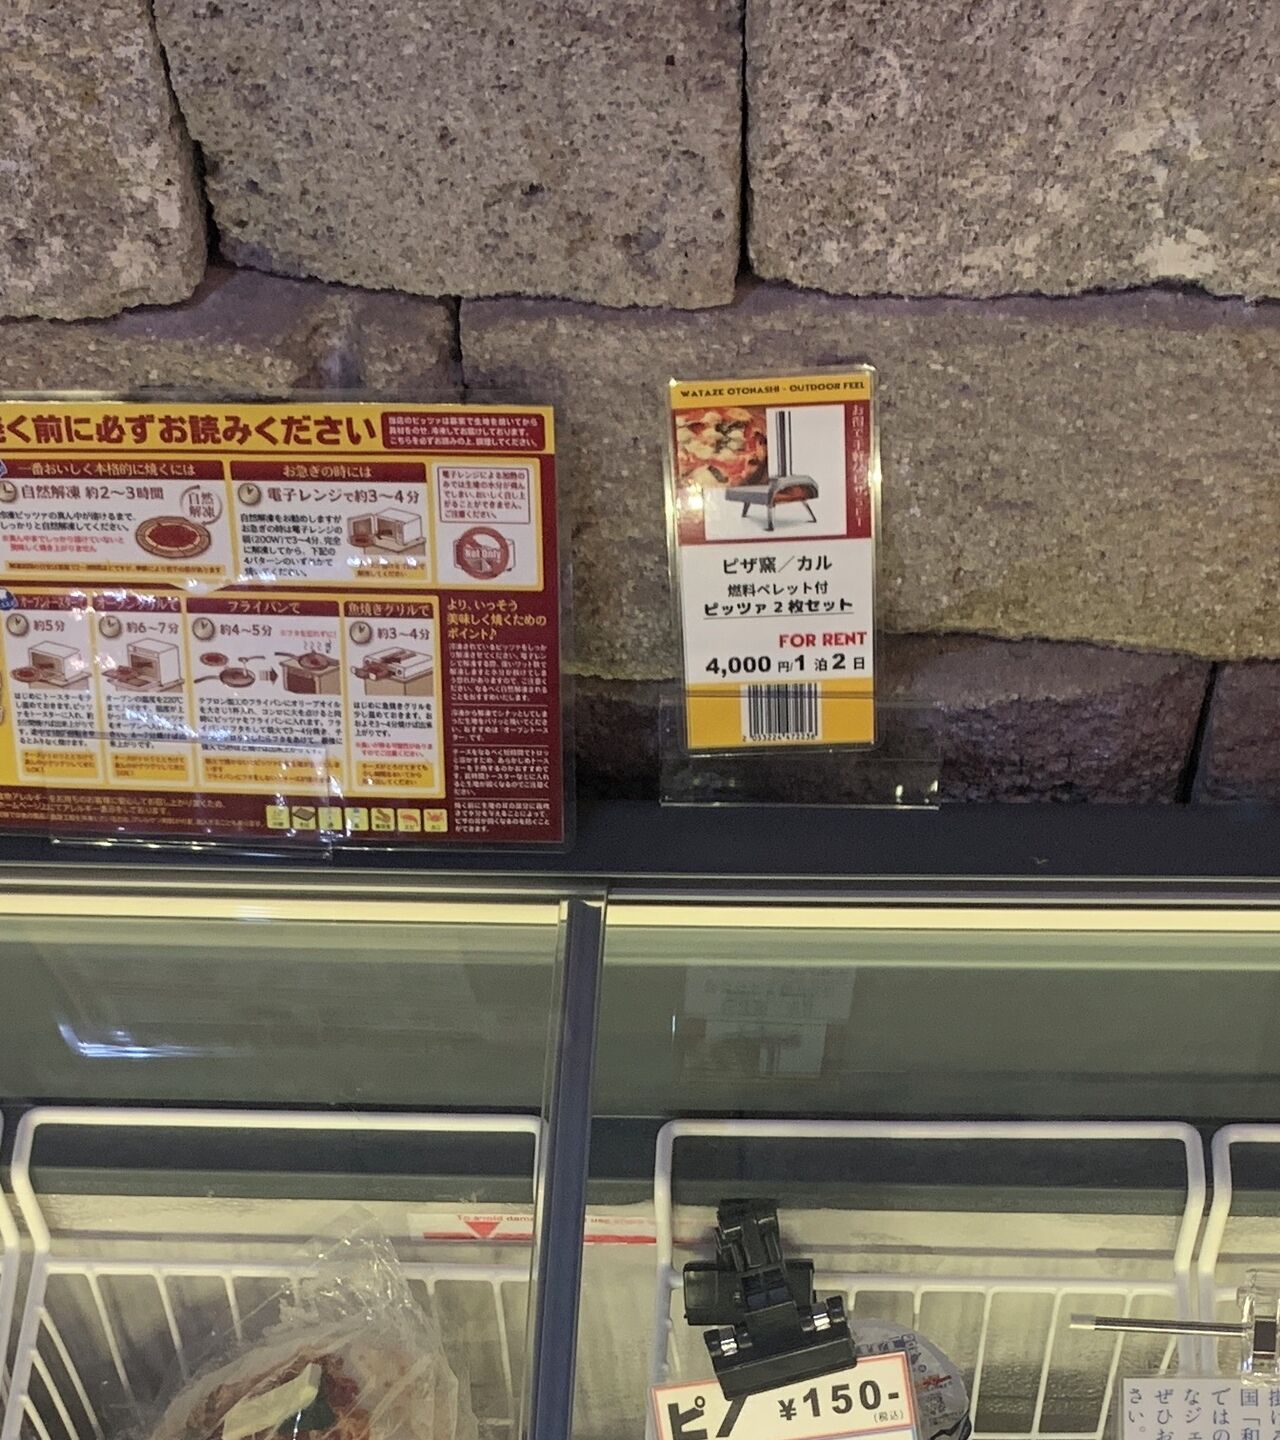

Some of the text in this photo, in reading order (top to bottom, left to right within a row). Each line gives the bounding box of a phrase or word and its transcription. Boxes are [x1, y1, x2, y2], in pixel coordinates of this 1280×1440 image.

[681, 389, 724, 398] WATAZE
[790, 383, 840, 393] OUTDOOR
[844, 381, 865, 390] FEEL
[19, 463, 196, 477] 一番おいしく本格的に焼くには
[283, 464, 372, 478] お急ぎの時には
[21, 485, 80, 499] 自然解凍
[188, 492, 214, 506] 自然
[188, 505, 215, 519] 解凍
[728, 582, 827, 598] 燃料ペレット付
[228, 600, 300, 614] フライパンで
[348, 603, 430, 617] 魚焼きグリルで
[34, 620, 65, 632] 約5分
[780, 632, 867, 648] FOR RENT
[873, 1409, 904, 1423] (税込)
[1128, 1387, 1147, 1434] さい。
